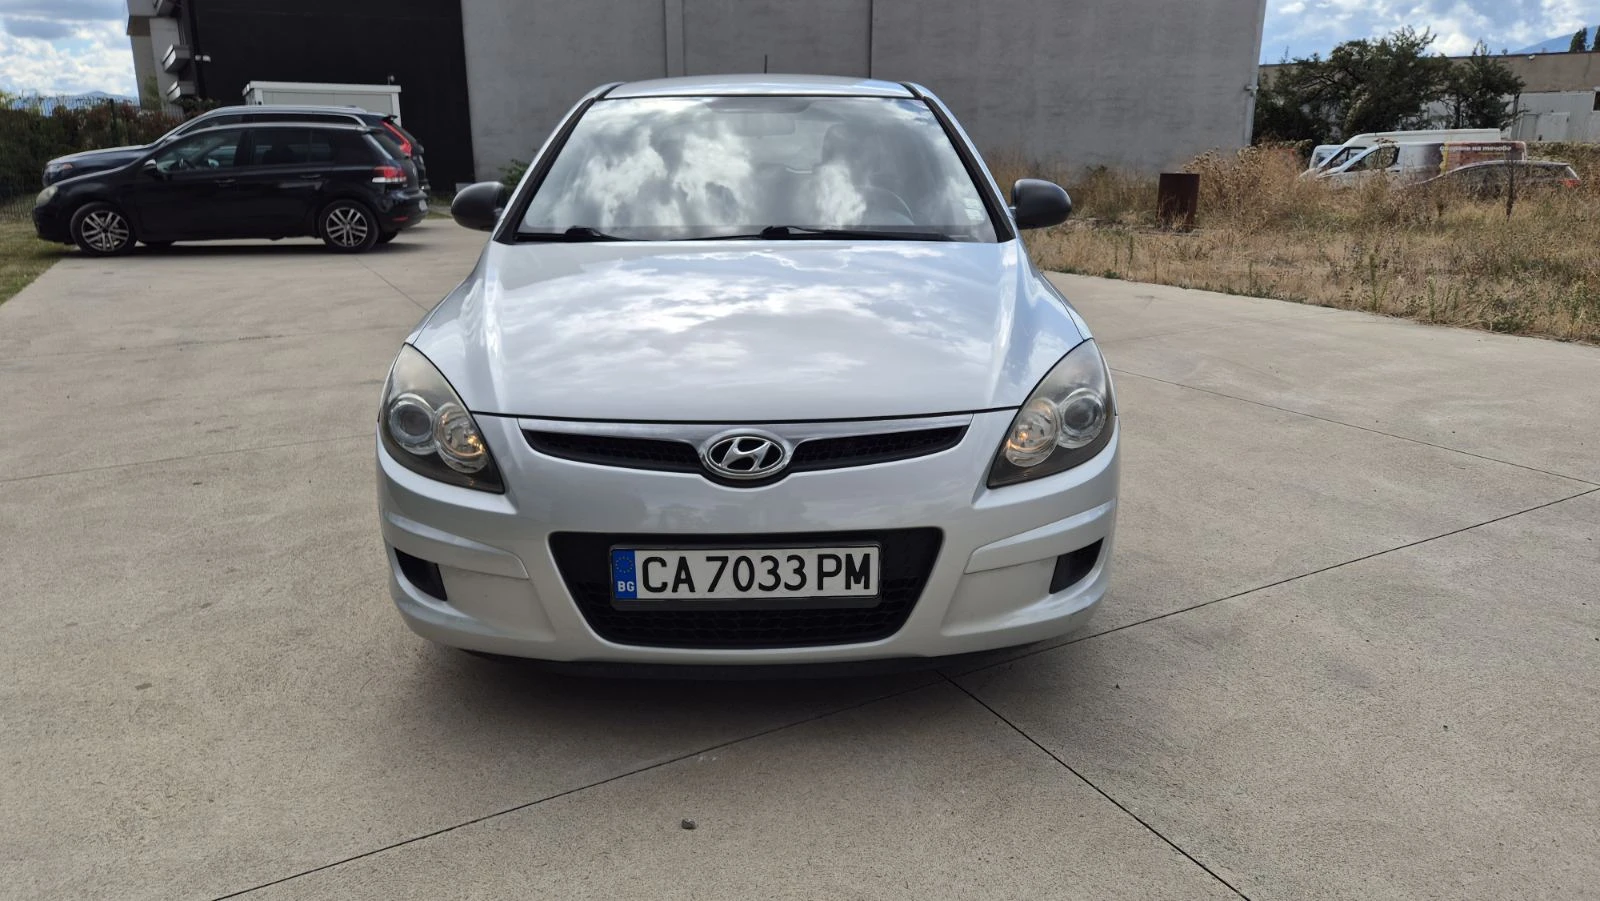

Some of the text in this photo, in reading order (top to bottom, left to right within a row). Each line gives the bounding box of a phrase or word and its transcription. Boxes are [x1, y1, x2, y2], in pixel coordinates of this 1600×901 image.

[617, 580, 635, 592] BG
[641, 553, 871, 593] CA 7033 PM
